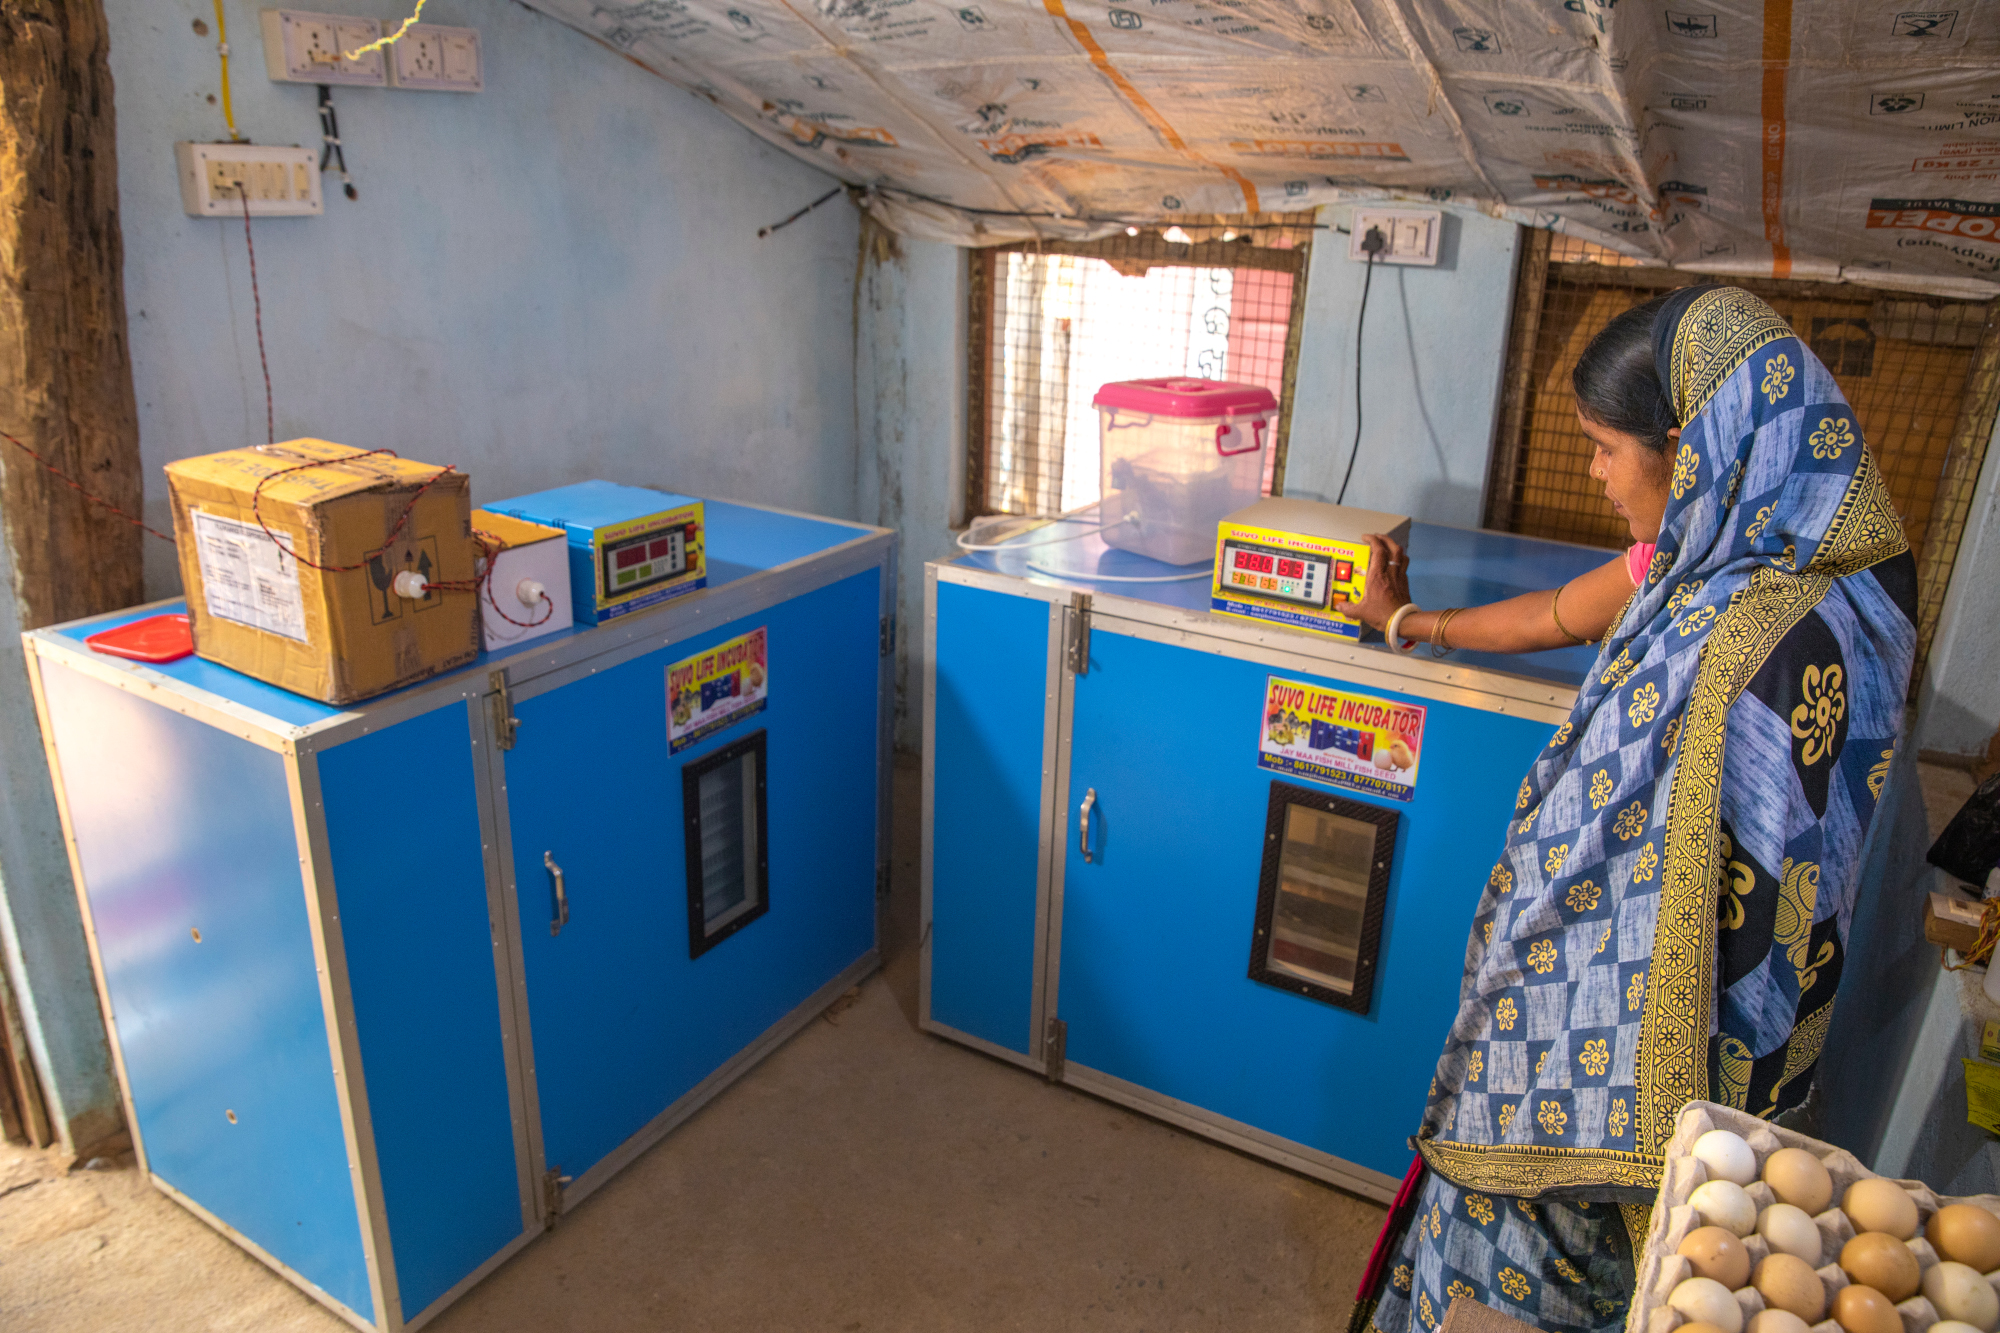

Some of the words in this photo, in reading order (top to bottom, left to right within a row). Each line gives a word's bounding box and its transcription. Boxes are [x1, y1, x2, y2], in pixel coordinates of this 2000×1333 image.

[1955, 202, 1995, 213] 100%
[1873, 211, 2000, 240] OPEL
[1230, 530, 1259, 540] SUVO
[1262, 535, 1285, 545] LIFE
[1288, 539, 1355, 557] INCUBATOR
[1279, 558, 1305, 579] 53
[1260, 576, 1278, 590] 65
[1269, 684, 1305, 711] SUVO
[1307, 692, 1338, 718] LIFE
[1338, 699, 1420, 738] INCUBATOR
[1264, 753, 1284, 765] Mob
[1294, 760, 1346, 780] 8617791523
[1353, 774, 1408, 794] 8777078117
[1280, 748, 1294, 756] JAY
[1296, 751, 1314, 760] MAA
[1315, 755, 1333, 765] FISH
[1334, 759, 1352, 770] MILL
[1354, 764, 1373, 774] FISH
[1374, 768, 1397, 780] SEED
